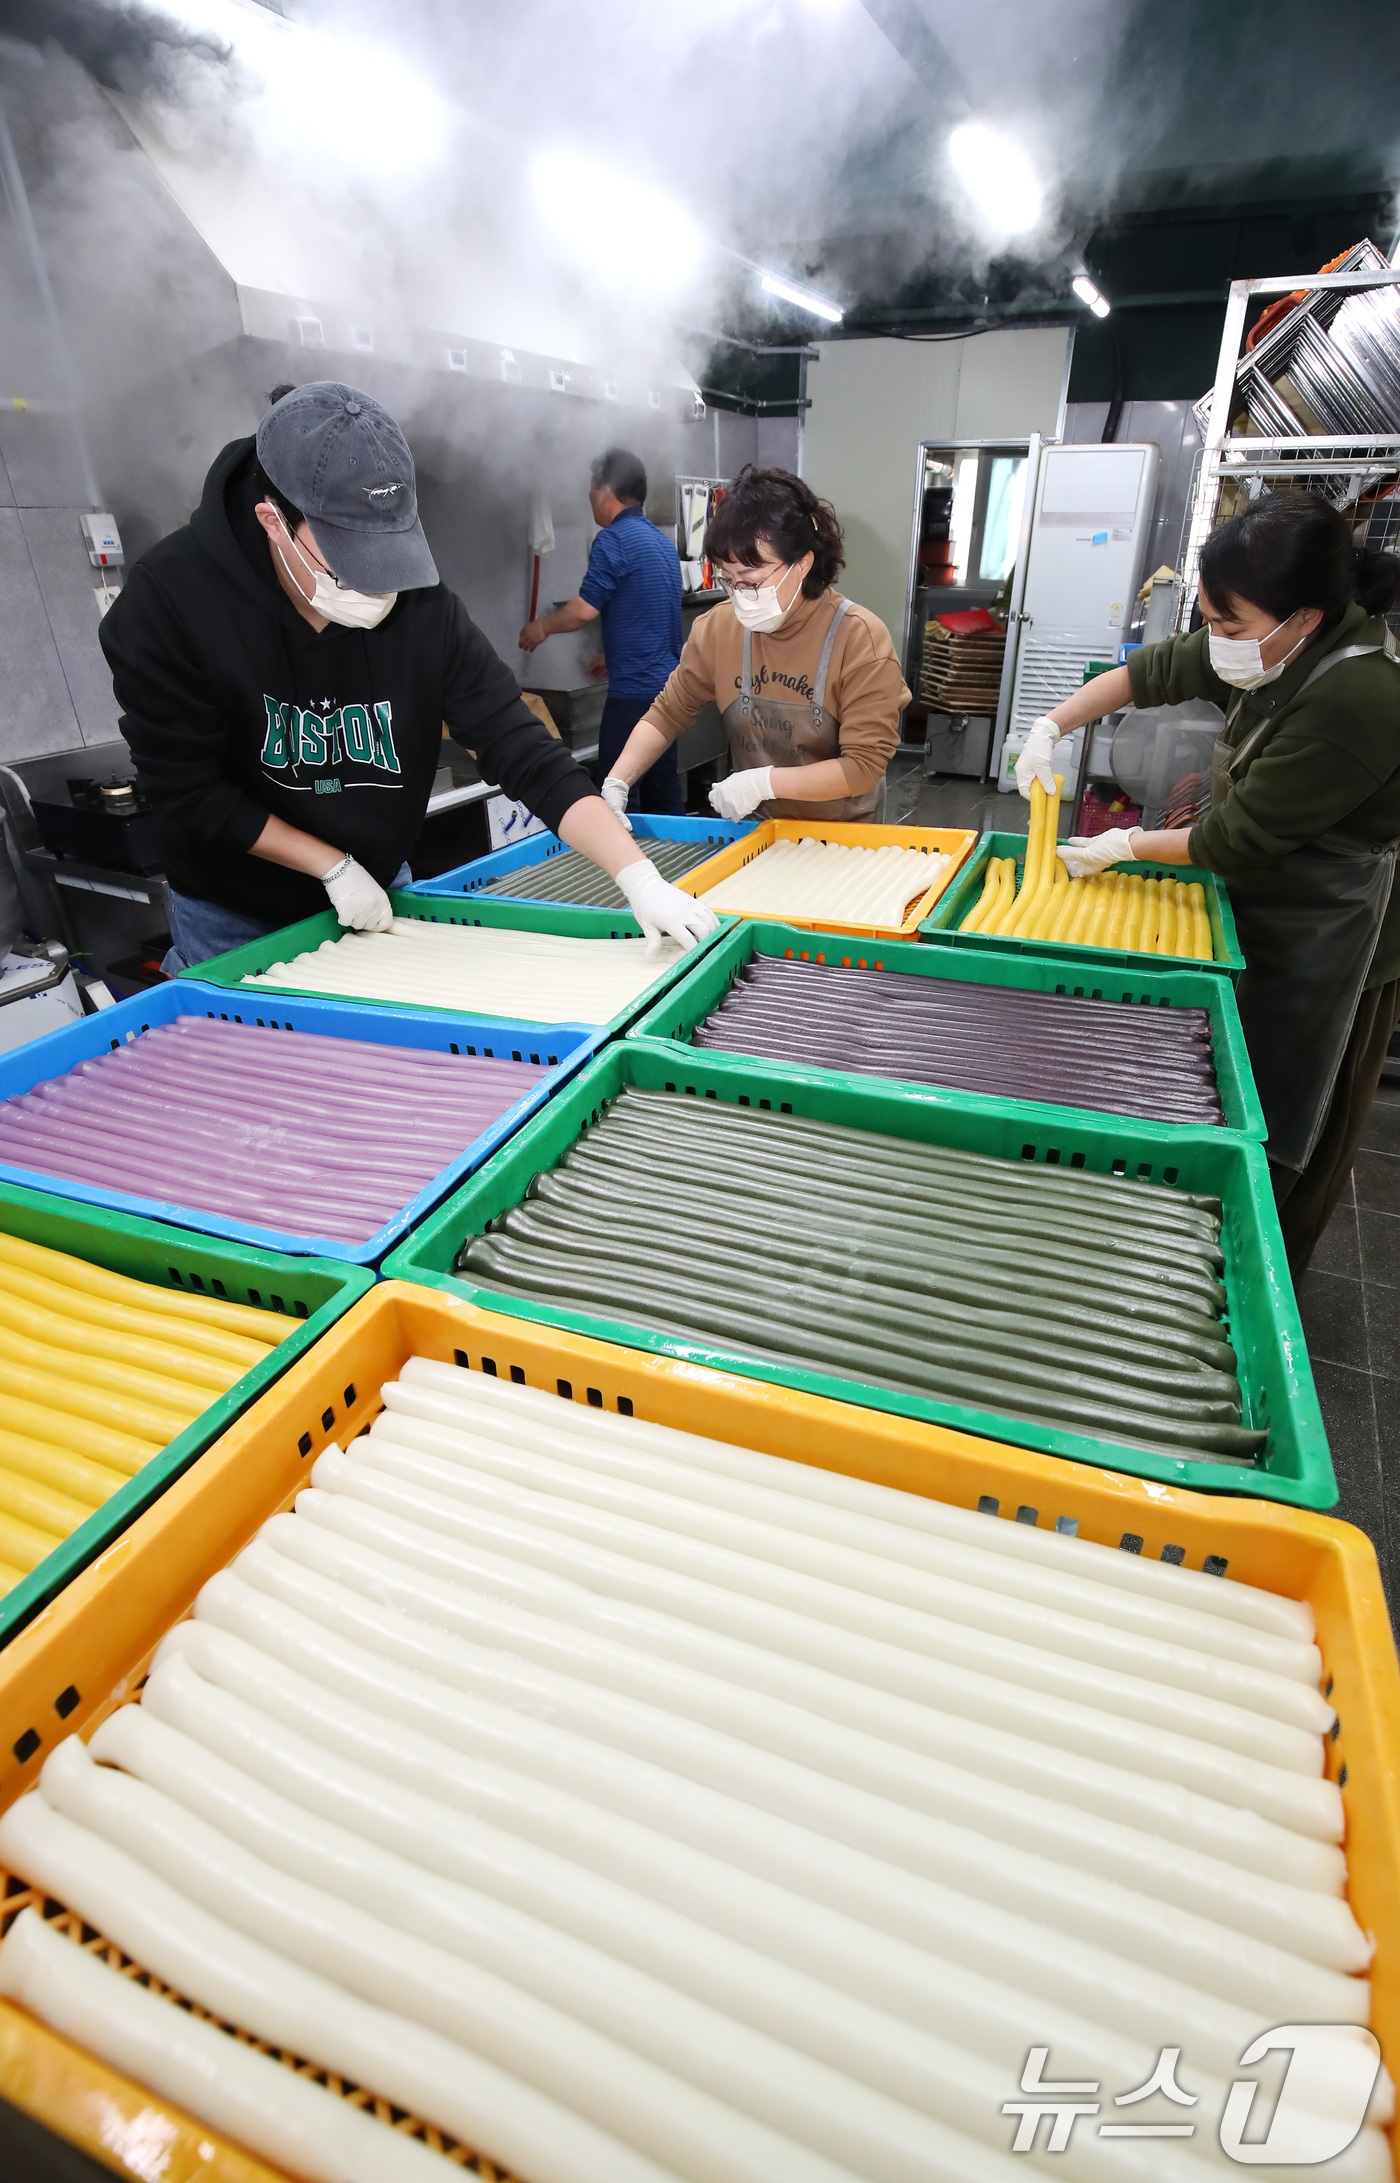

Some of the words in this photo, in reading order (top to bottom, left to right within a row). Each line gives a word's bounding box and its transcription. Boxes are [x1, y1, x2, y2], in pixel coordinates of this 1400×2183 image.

[772, 671, 814, 700] make
[261, 693, 401, 774] BOSTON
[314, 778, 342, 794] USA
